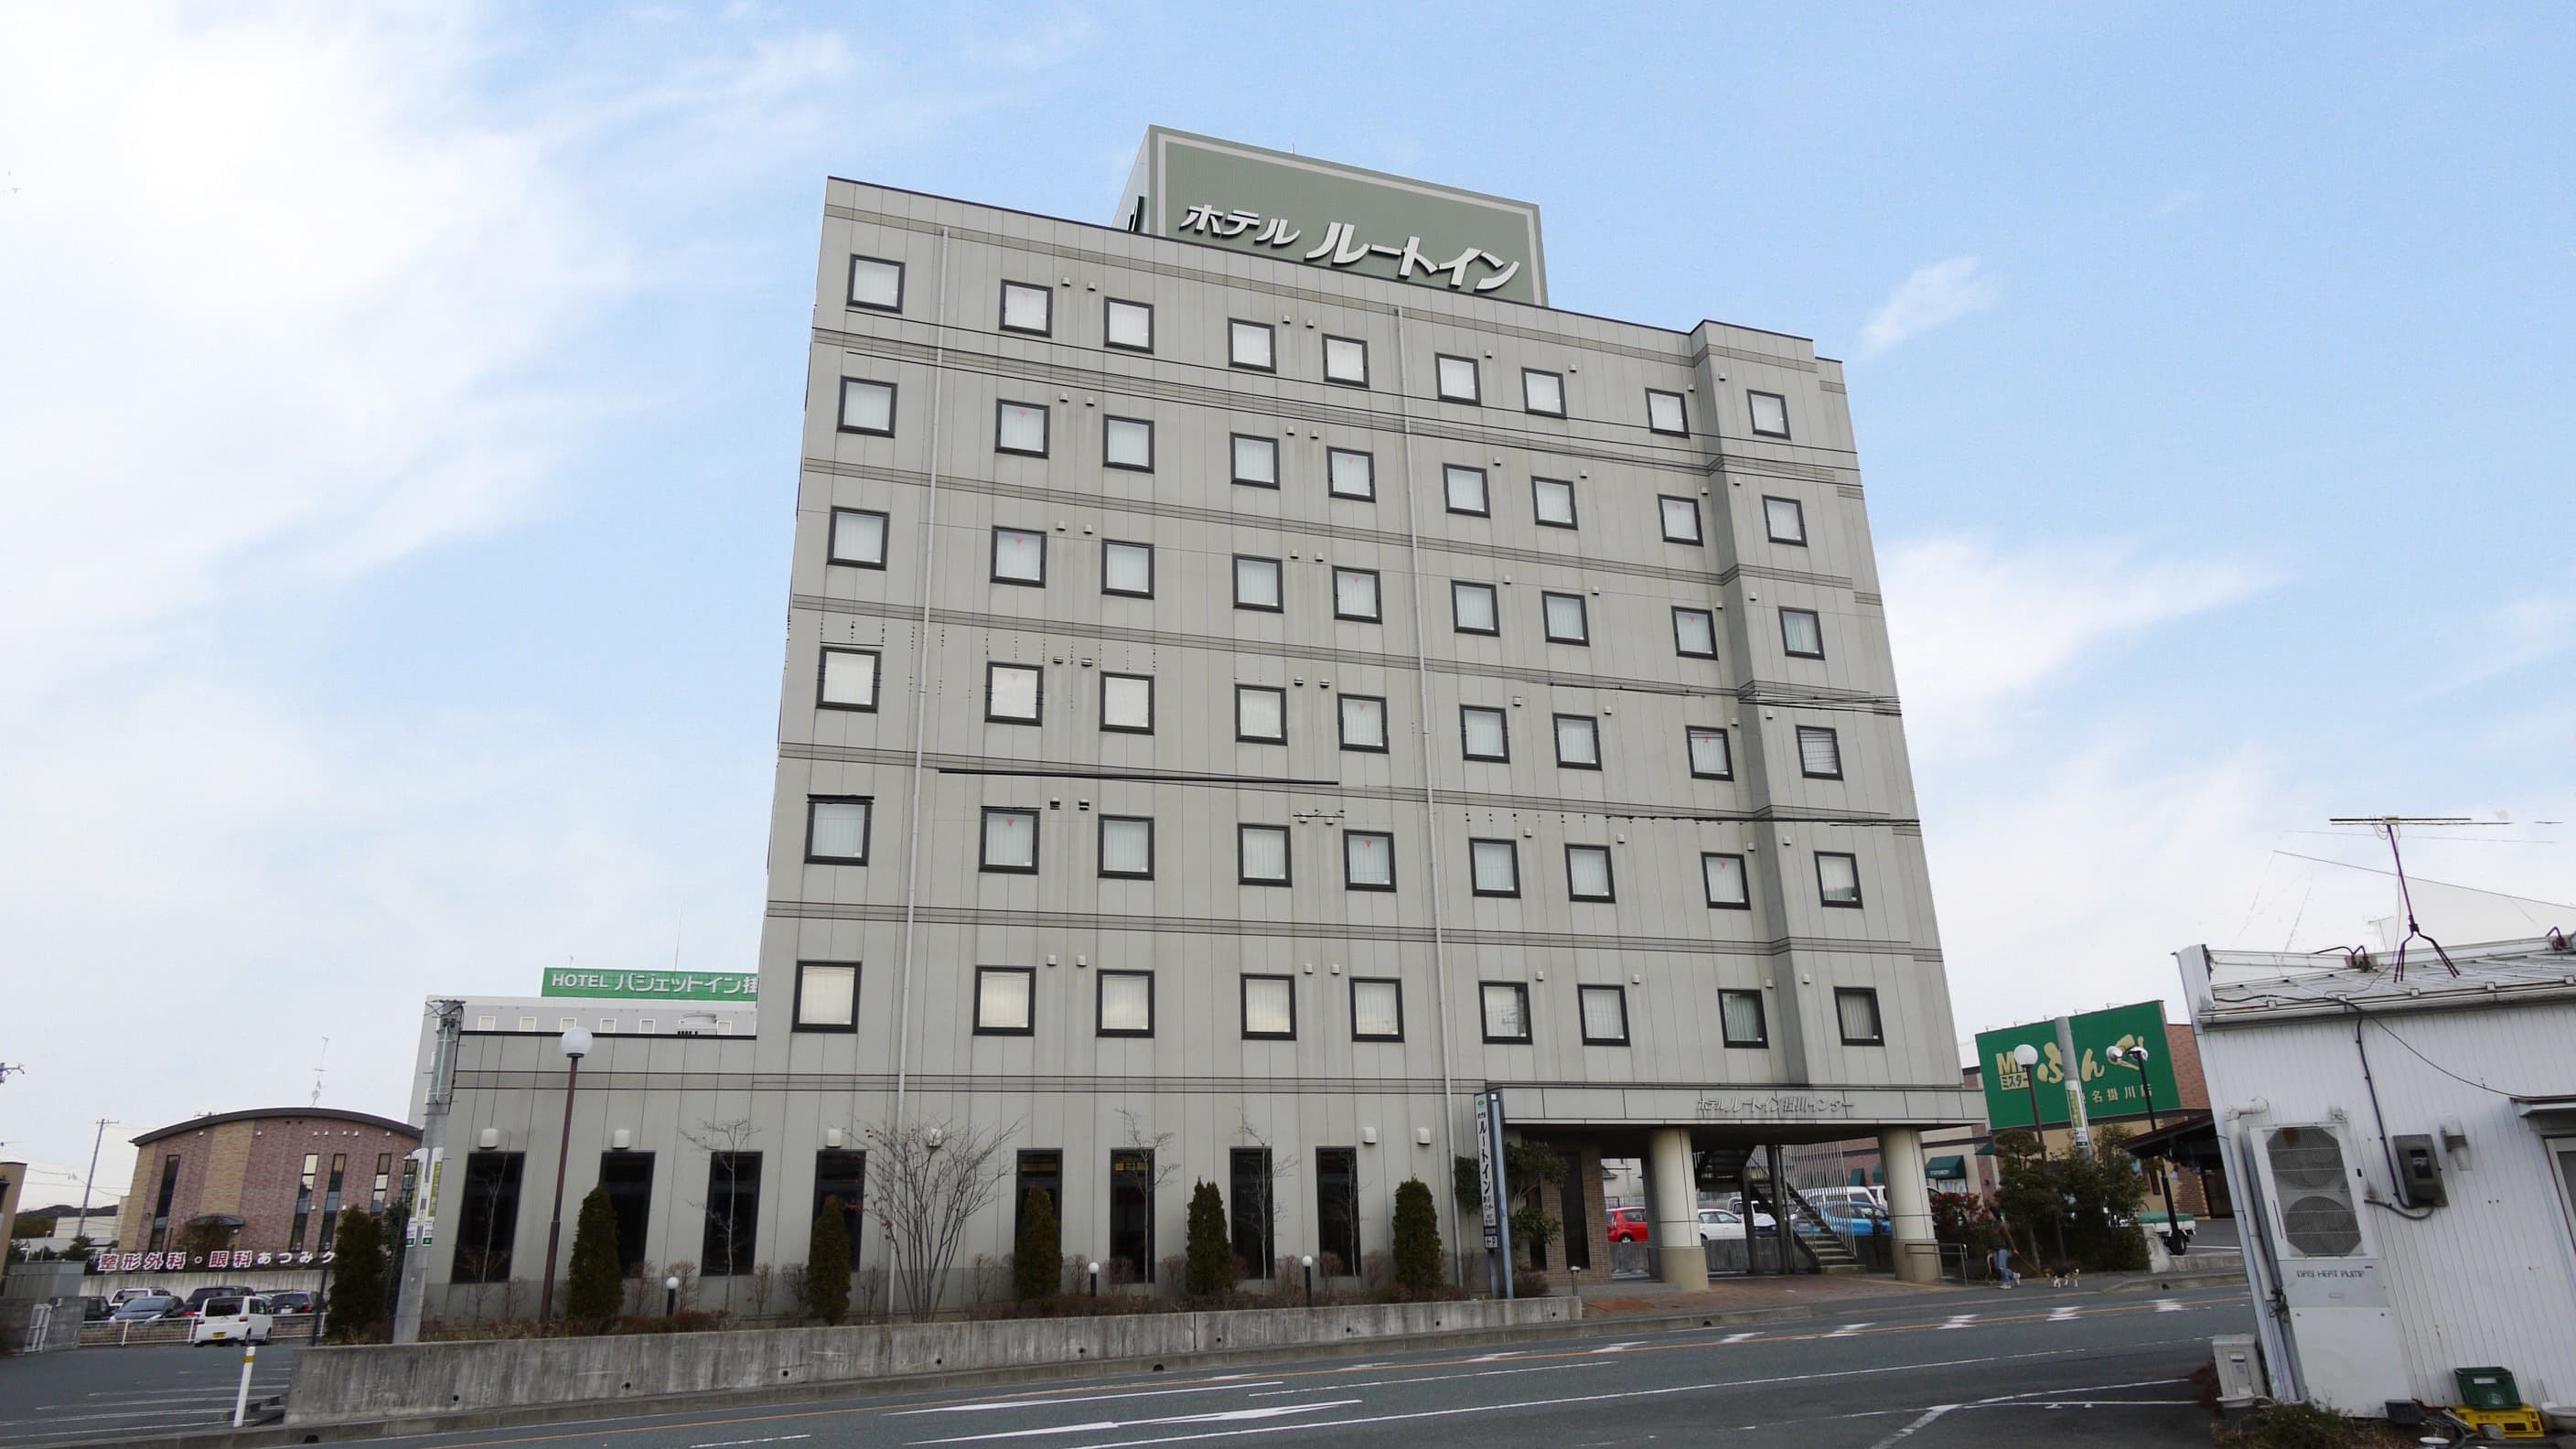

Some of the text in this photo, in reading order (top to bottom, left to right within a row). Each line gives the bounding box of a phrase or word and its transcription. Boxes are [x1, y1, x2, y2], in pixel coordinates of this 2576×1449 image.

[1179, 203, 1520, 292] ホテル ルートイン
[552, 973, 609, 989] HOTEL
